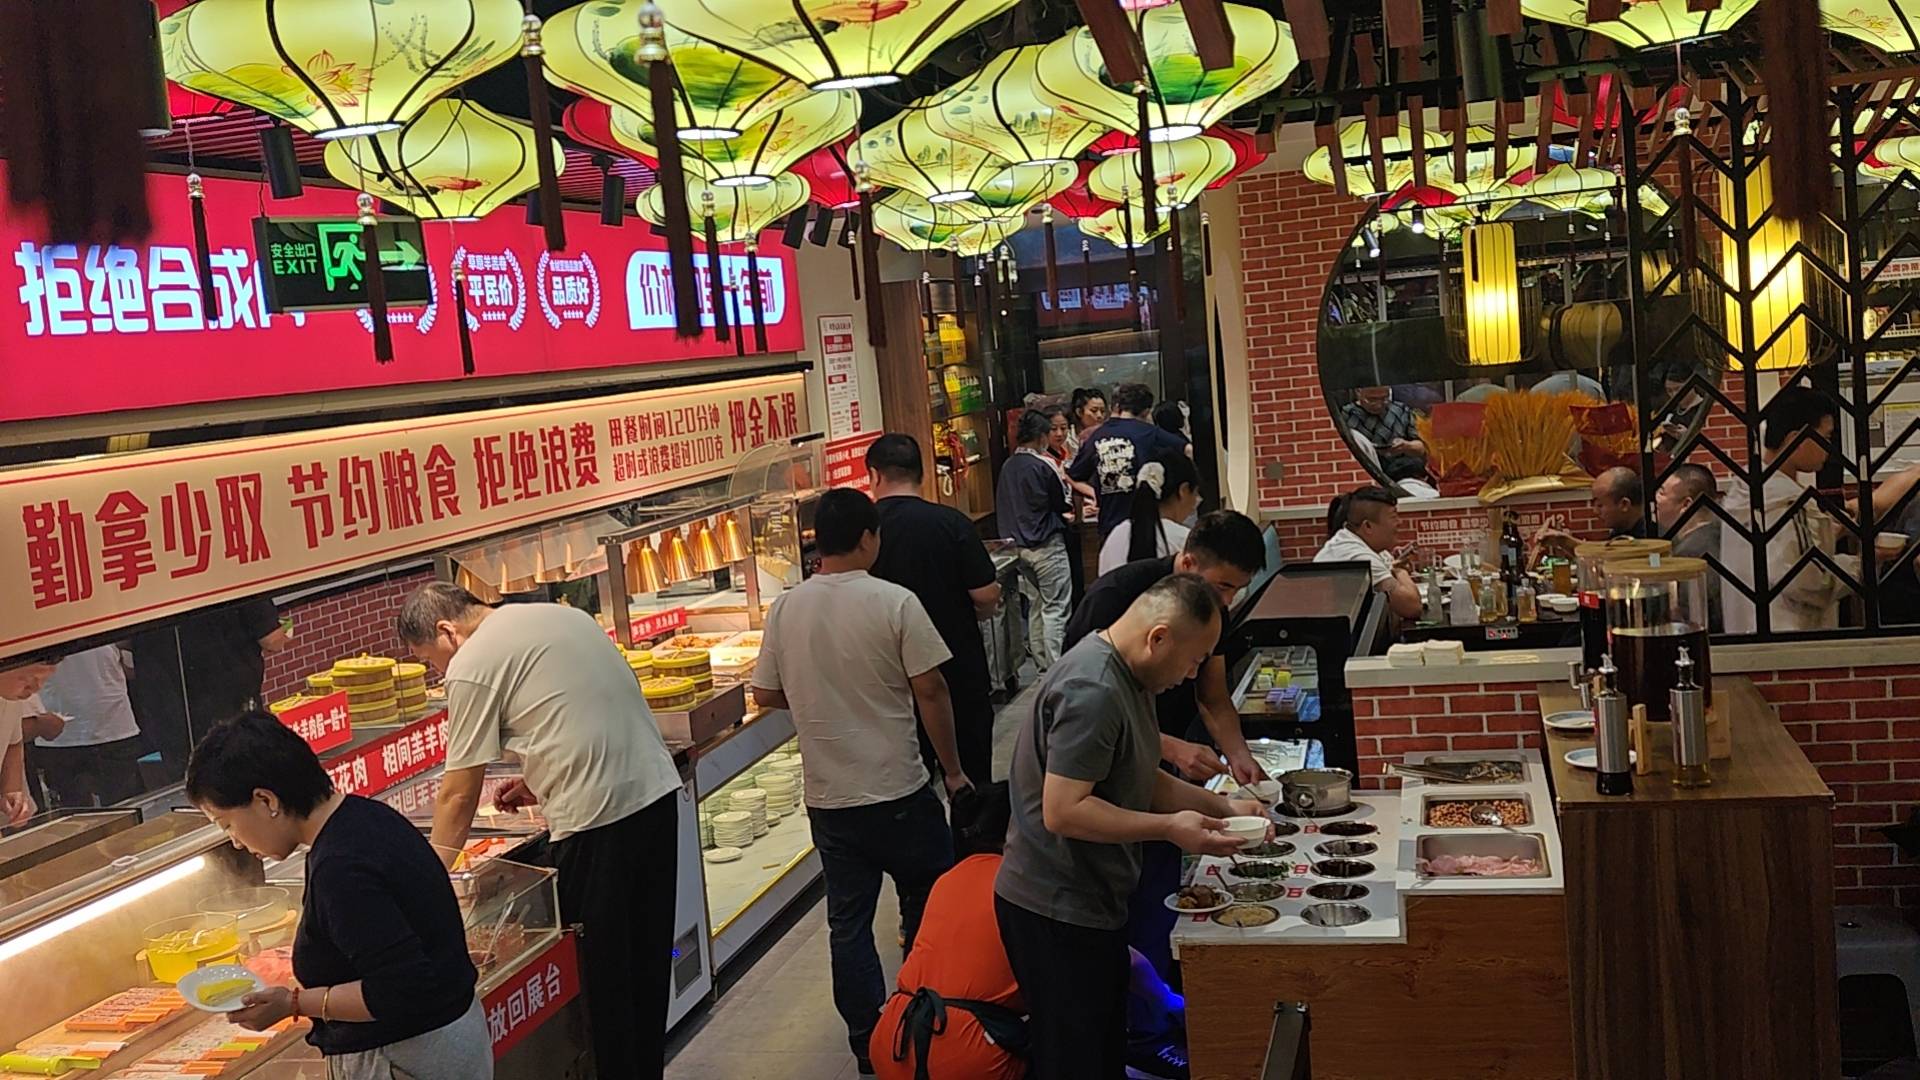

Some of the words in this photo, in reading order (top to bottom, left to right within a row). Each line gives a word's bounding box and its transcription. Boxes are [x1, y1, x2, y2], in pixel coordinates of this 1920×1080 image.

[270, 243, 317, 258] 安全出口
[273, 259, 318, 275] EXIT
[15, 241, 306, 336] 拒绝合成
[468, 274, 514, 307] 平民价
[552, 275, 590, 306] 品质好
[608, 403, 721, 447] 用餐时间120分钟
[728, 391, 799, 454] 押金不退
[613, 434, 725, 483] 超时或浪费超过100克
[23, 473, 271, 609] 勤拿少取
[288, 443, 461, 549] 节约粮食
[473, 421, 600, 510] 拒绝浪费
[487, 962, 561, 1043] 放回展台
